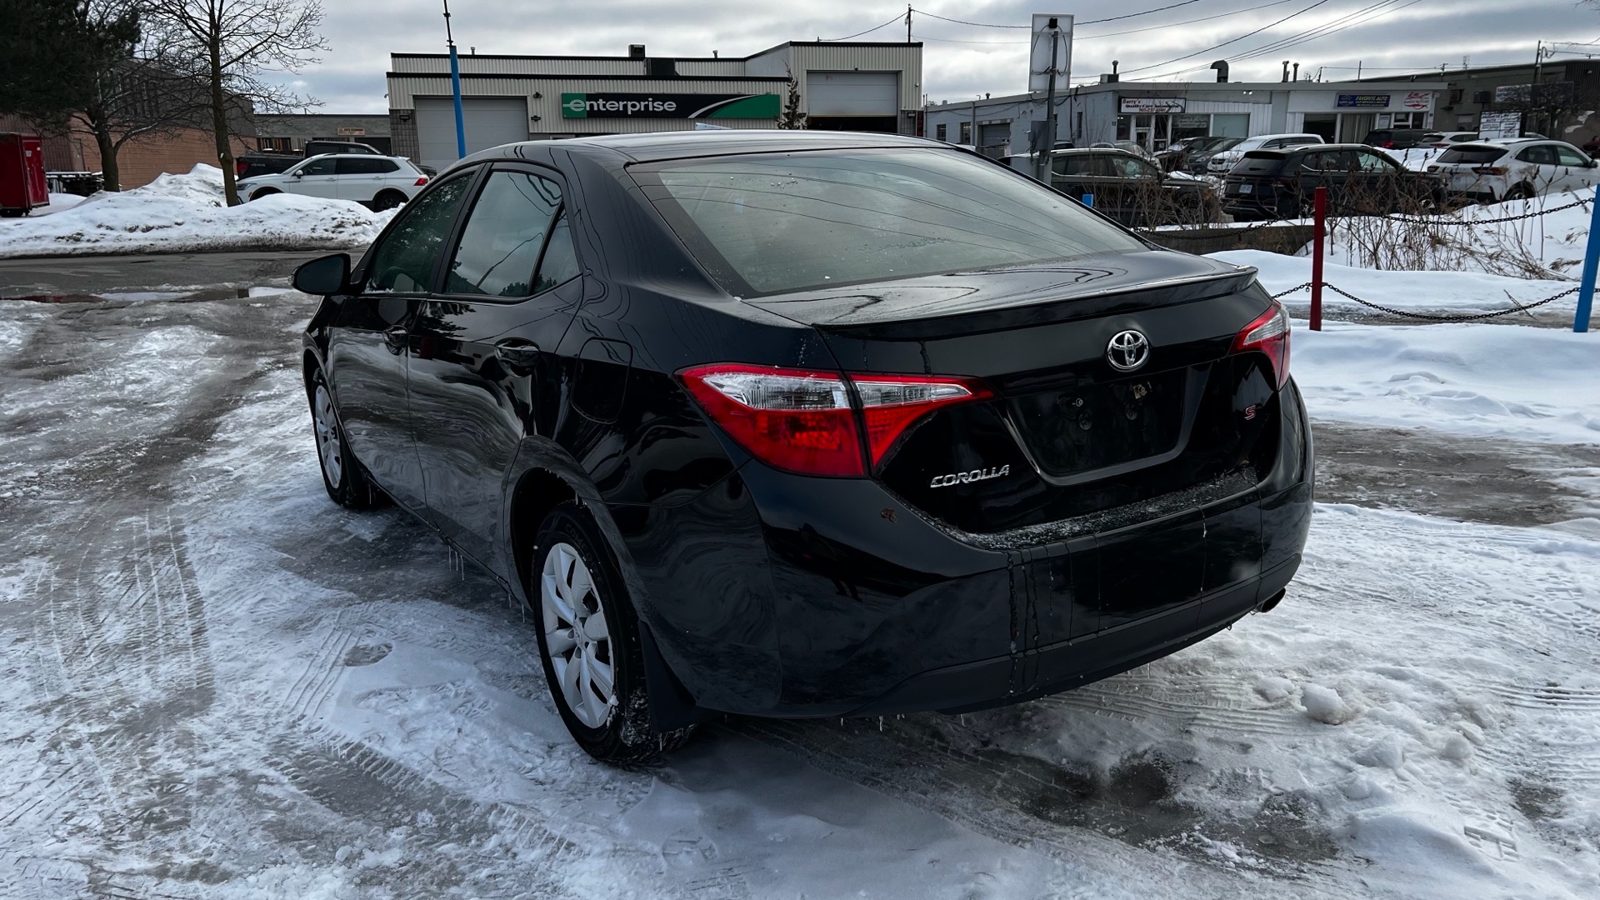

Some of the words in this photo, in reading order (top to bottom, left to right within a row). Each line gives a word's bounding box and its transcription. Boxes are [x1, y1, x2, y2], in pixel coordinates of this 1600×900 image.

[563, 98, 677, 115] enterprise
[1244, 405, 1256, 420] S
[930, 464, 1010, 488] COROLLA
